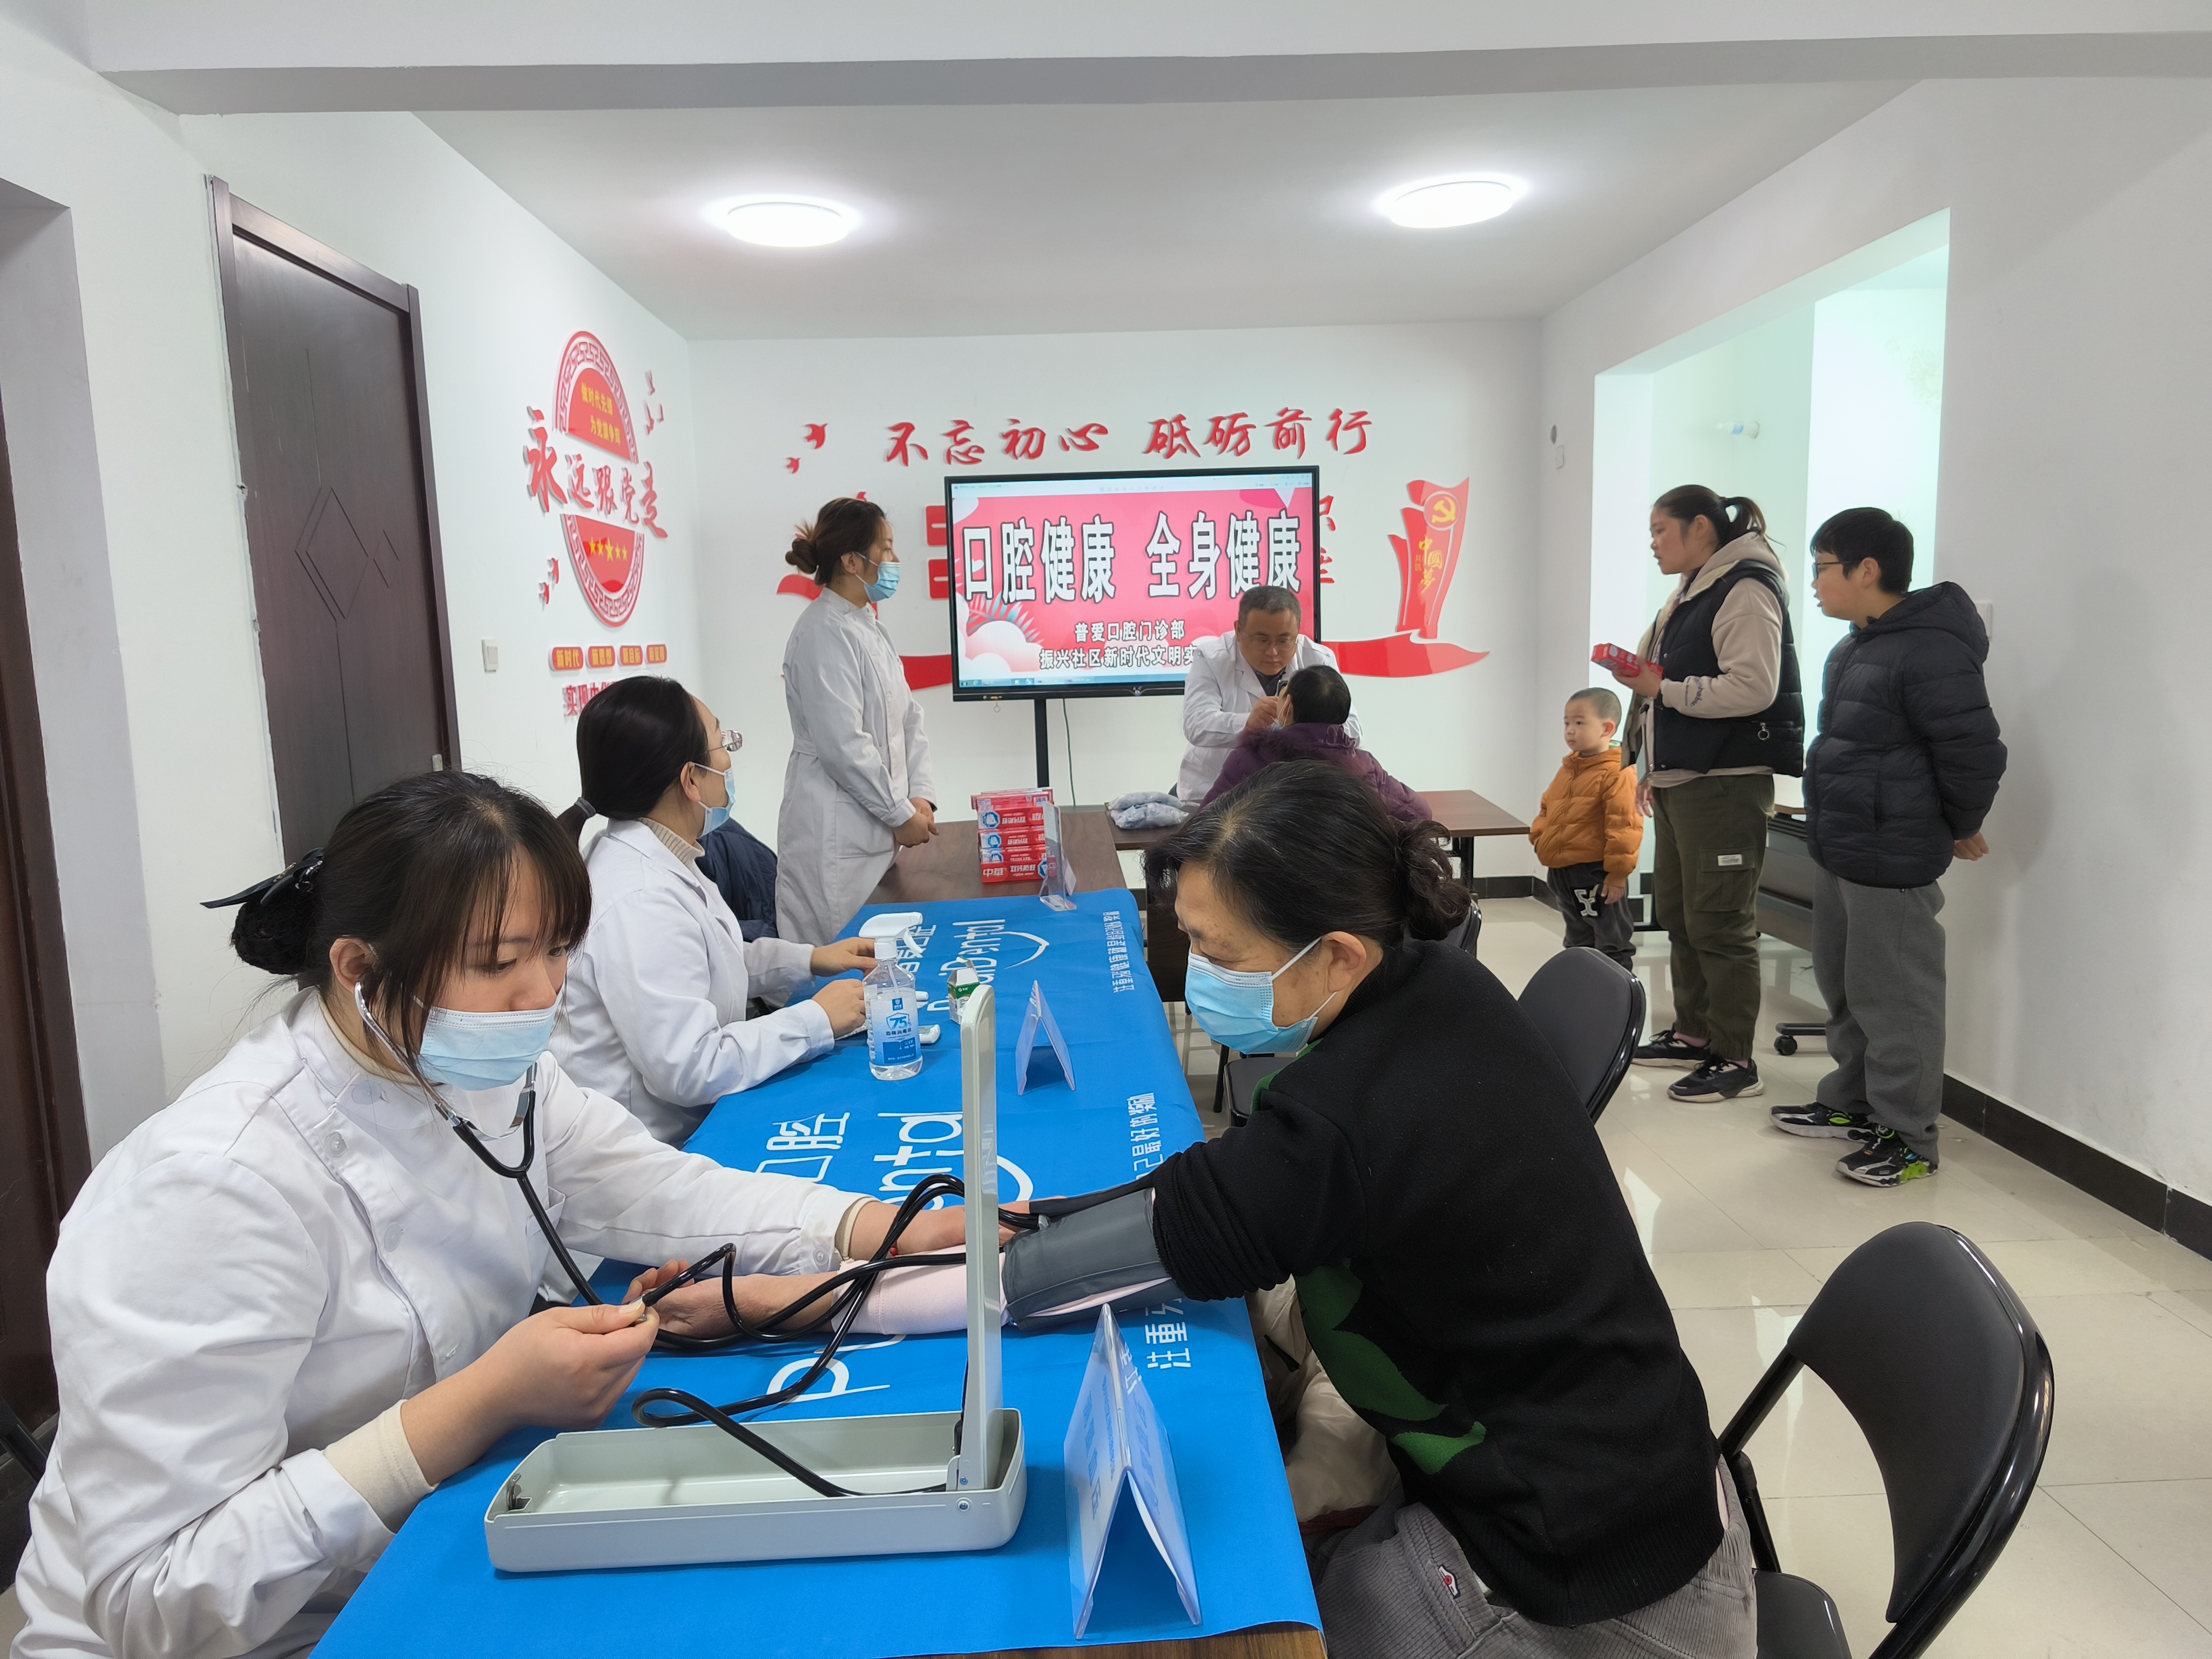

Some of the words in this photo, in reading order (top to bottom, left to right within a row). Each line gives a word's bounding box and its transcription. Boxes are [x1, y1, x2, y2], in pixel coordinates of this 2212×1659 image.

[886, 419, 1109, 467] 不忘初心
[1142, 407, 1372, 459] 砥砺前行
[524, 406, 668, 538] 永远跟党走
[961, 514, 1117, 604] 口腔健康
[1145, 509, 1301, 599] 全身健康
[1074, 619, 1185, 644] 普爱口腔门诊部
[556, 649, 580, 668] 新时代
[1039, 644, 1197, 670] 振兴社区新时代文明实
